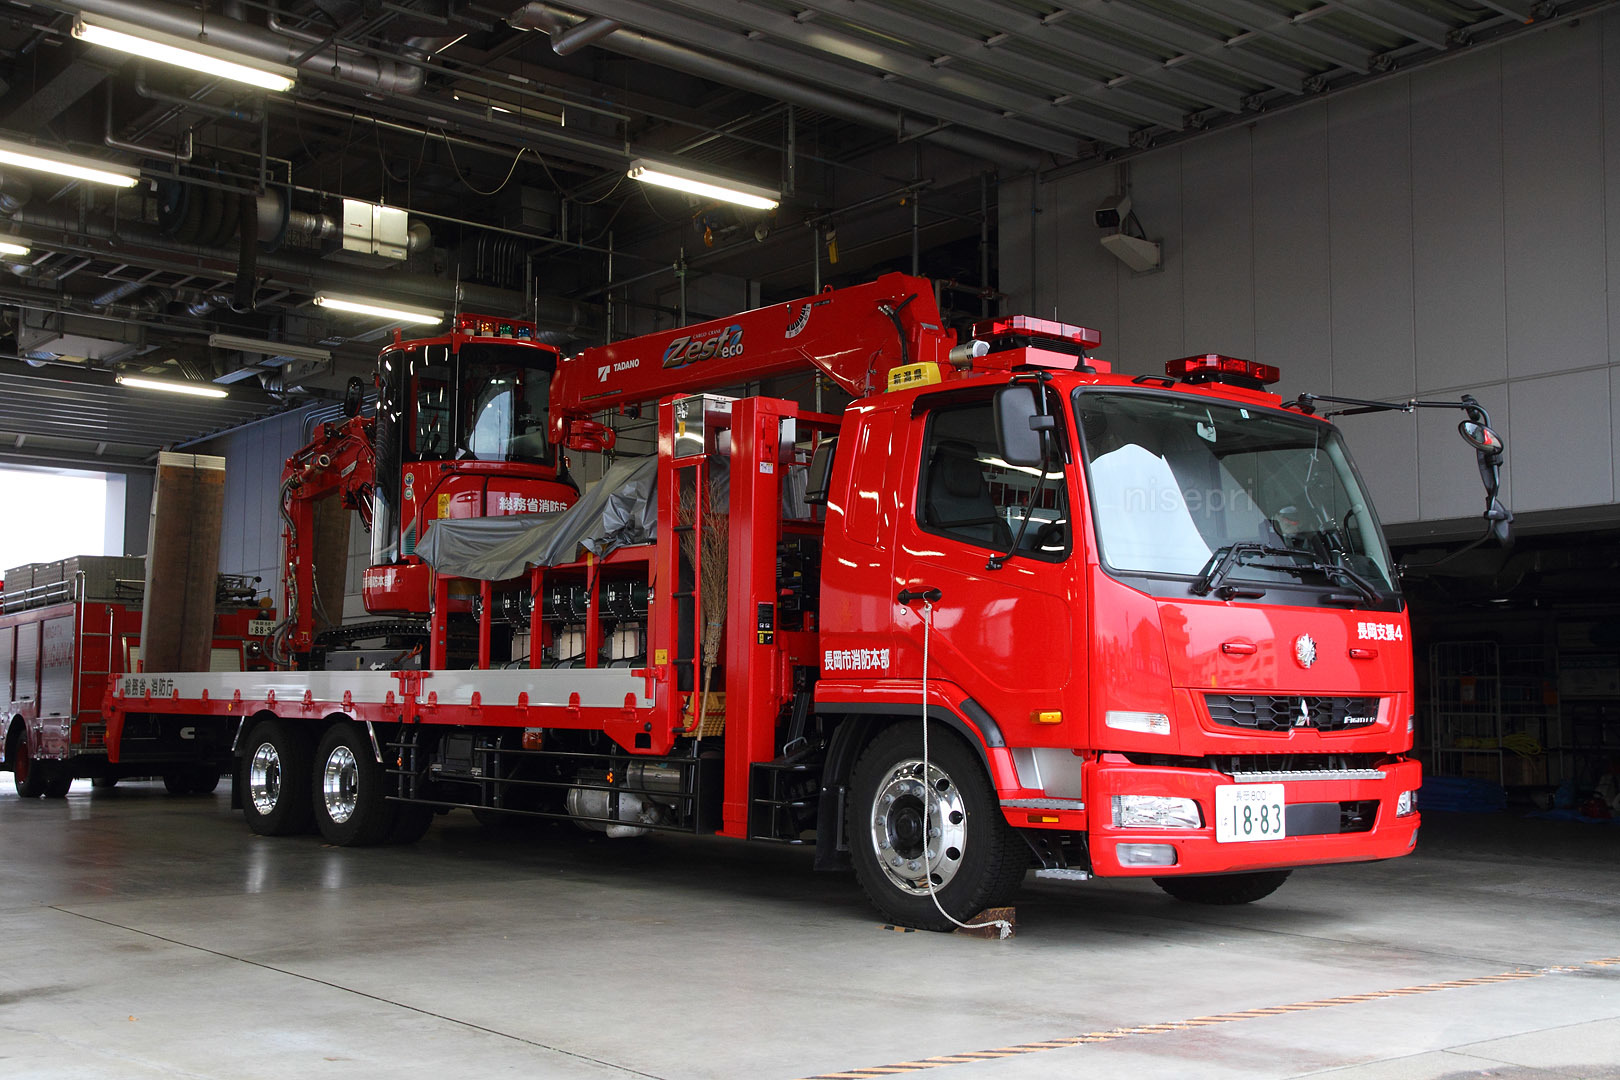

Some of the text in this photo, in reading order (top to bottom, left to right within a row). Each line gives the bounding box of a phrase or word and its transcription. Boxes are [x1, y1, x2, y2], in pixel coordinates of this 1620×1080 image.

[662, 326, 731, 369] Zest
[721, 343, 744, 358] eco
[613, 358, 640, 372] TADANO
[824, 647, 890, 671] 長岡市消防本部
